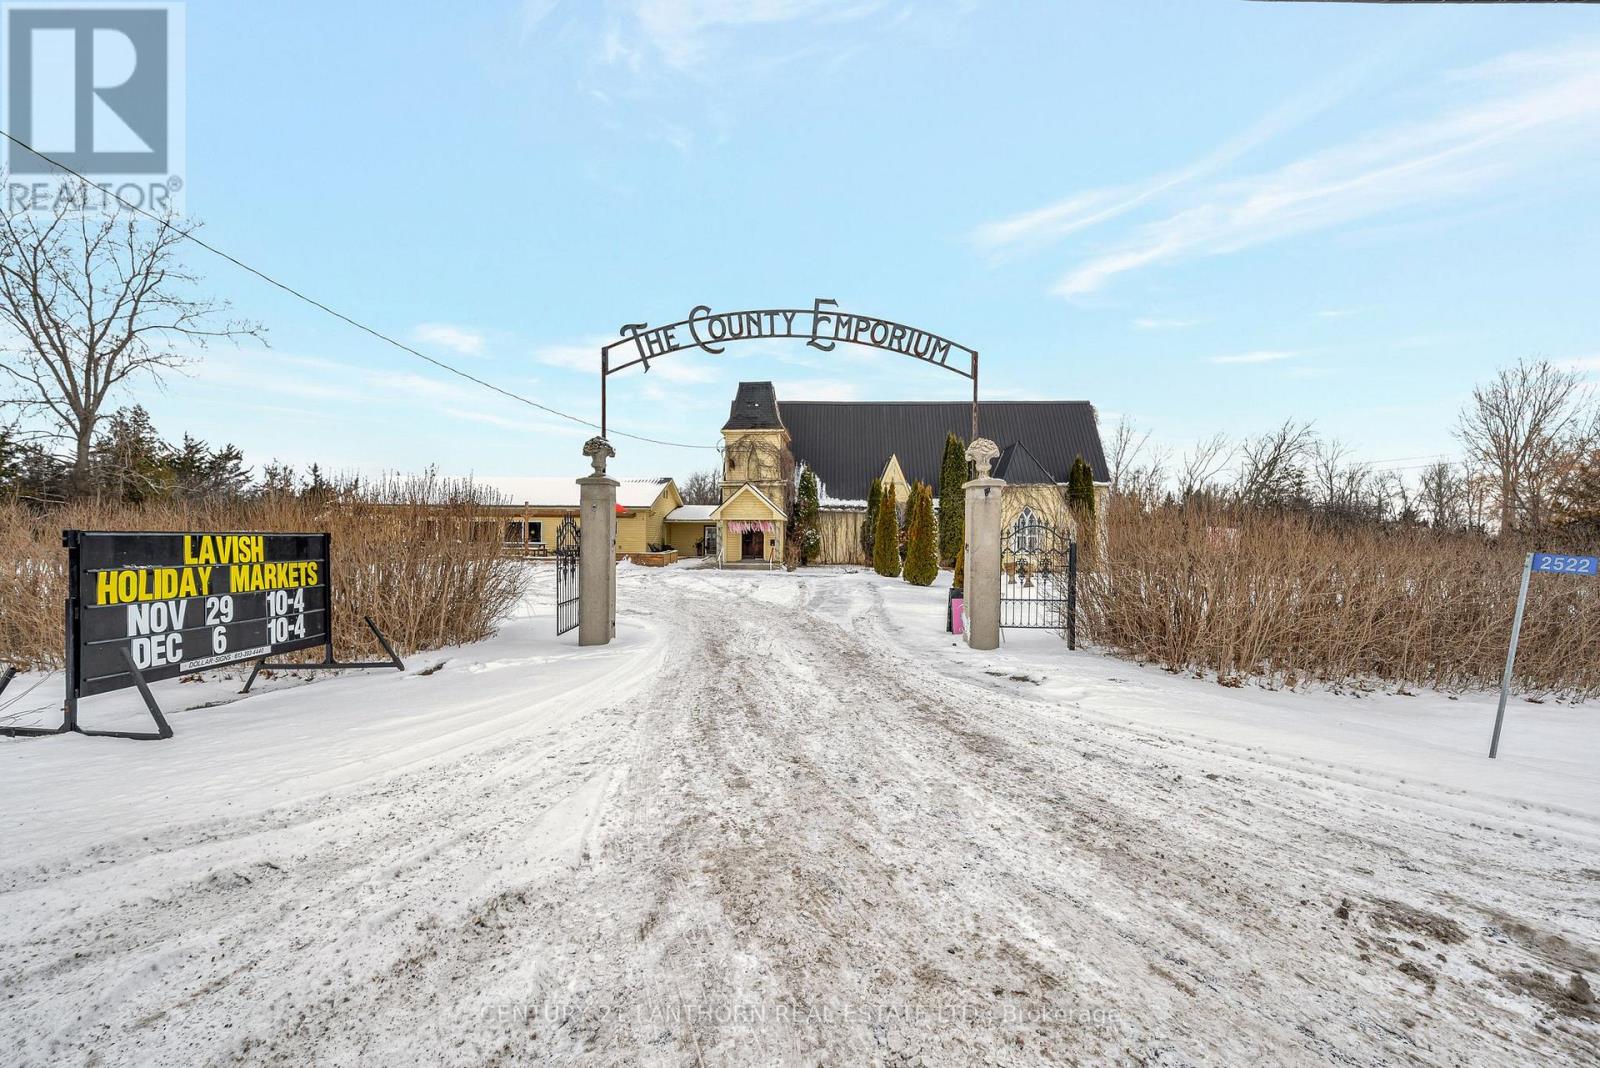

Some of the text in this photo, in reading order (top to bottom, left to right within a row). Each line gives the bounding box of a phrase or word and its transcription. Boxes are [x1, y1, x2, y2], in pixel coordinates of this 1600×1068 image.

[184, 535, 264, 565] LAVISH
[1541, 556, 1590, 572] 2522
[97, 561, 318, 605] HOLIDAY MARKETS
[127, 588, 305, 637] NOV 29 10-4
[131, 614, 306, 670] DEC 6 10-4
